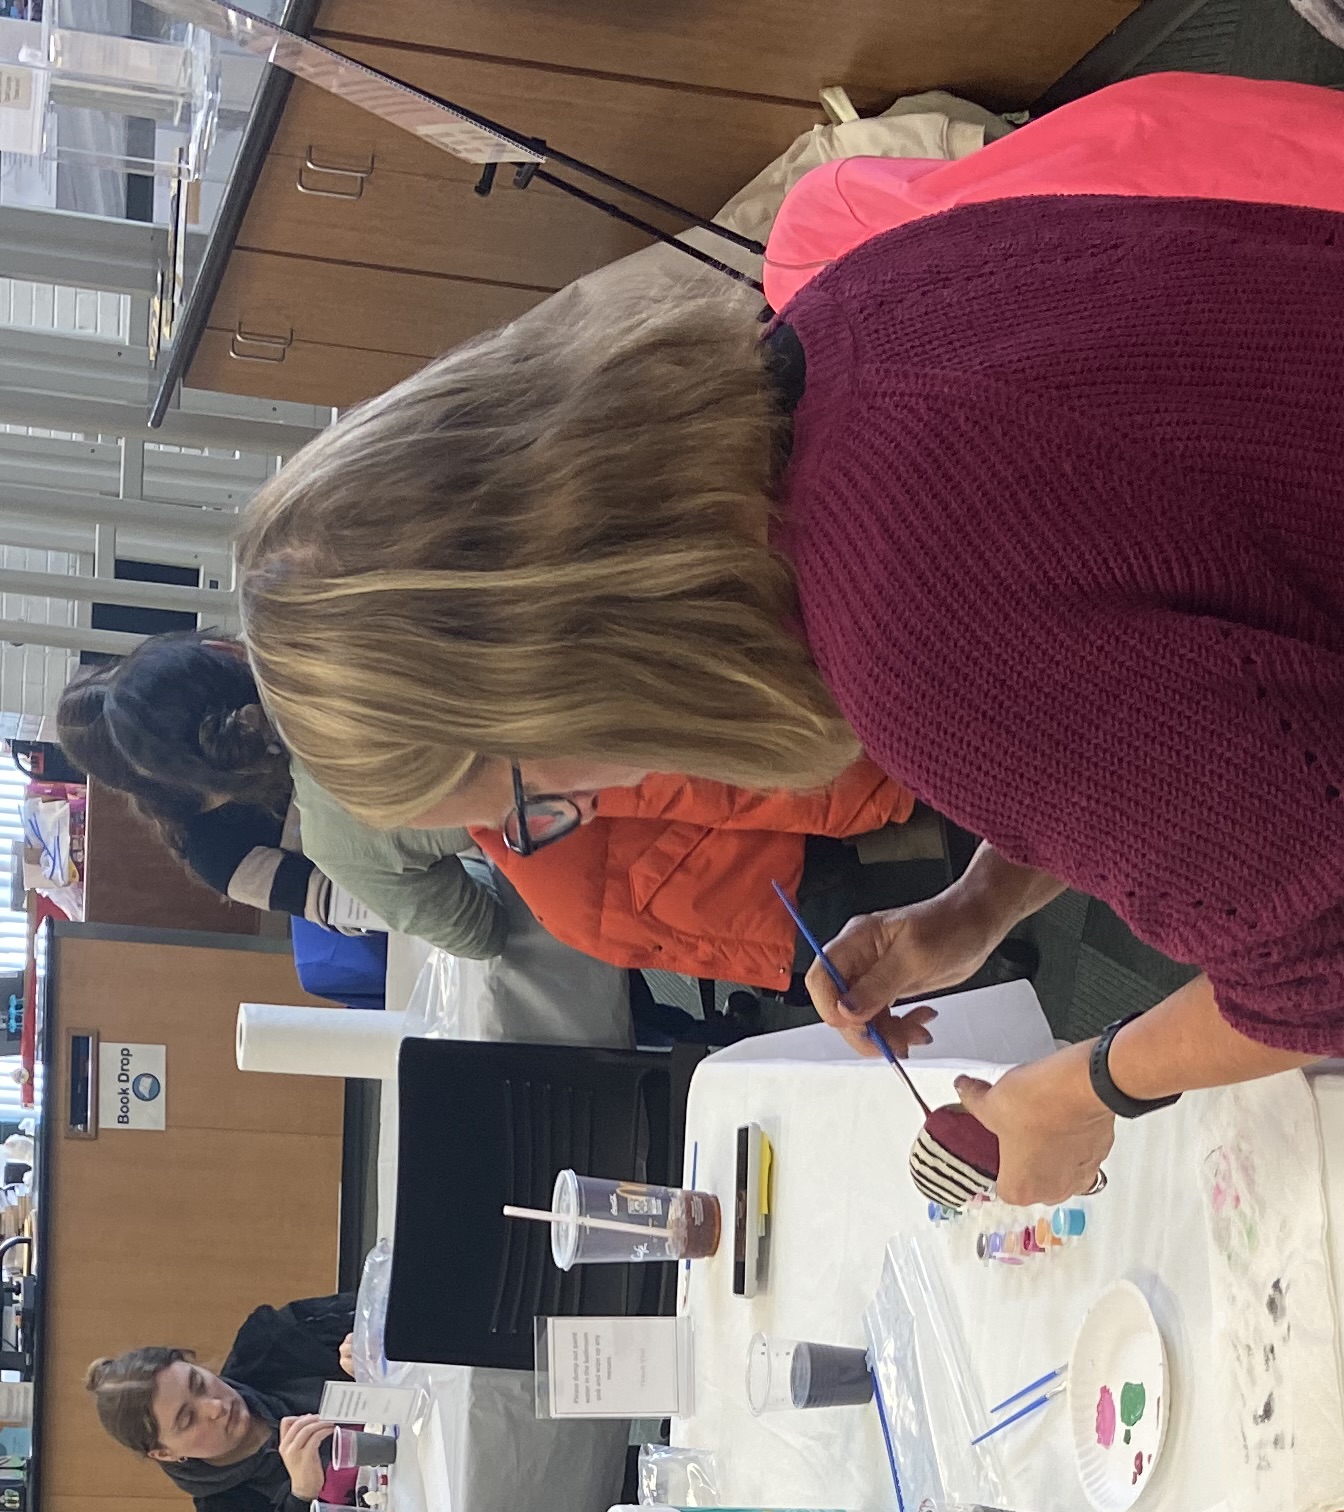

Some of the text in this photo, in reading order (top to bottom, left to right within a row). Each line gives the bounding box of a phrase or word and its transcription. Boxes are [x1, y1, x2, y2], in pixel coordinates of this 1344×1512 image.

[118, 1047, 133, 1124] Book Drop
[594, 1334, 602, 1346] any
[572, 1362, 580, 1381] dump
